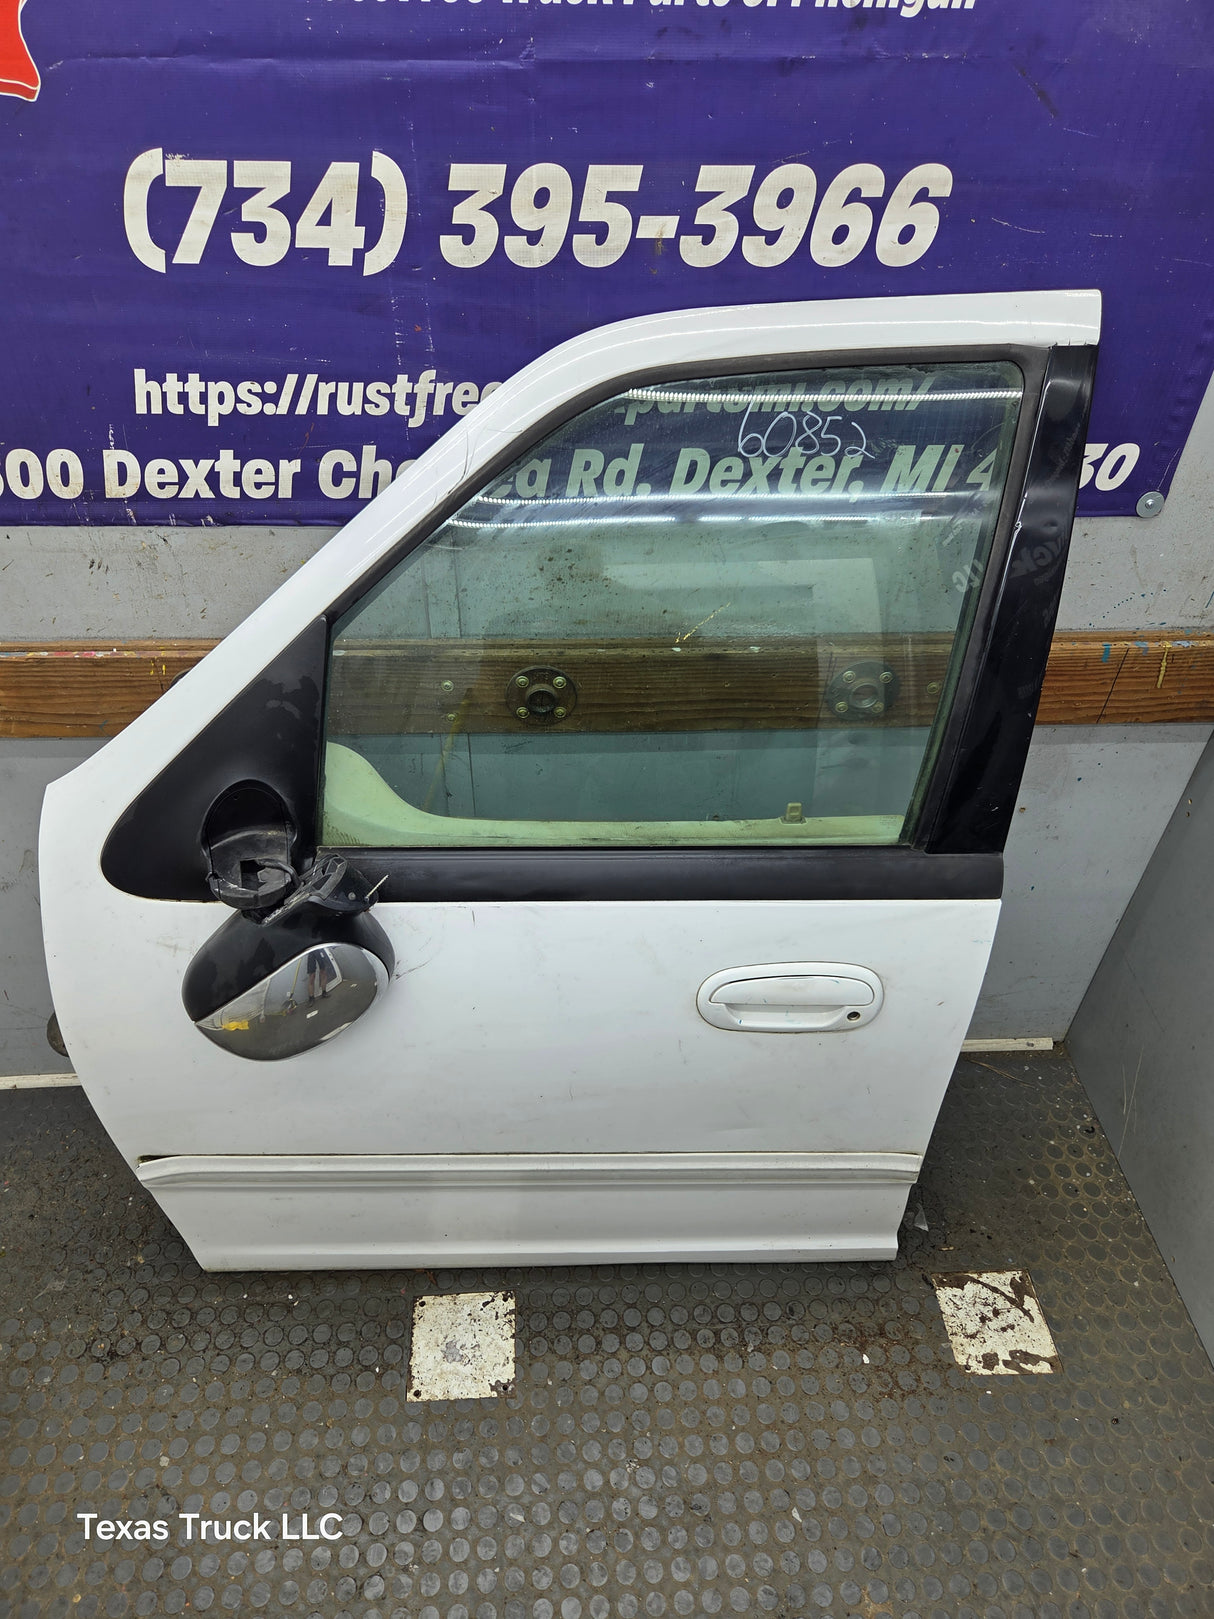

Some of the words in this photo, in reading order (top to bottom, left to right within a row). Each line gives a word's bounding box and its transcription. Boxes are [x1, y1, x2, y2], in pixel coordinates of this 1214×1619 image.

[124, 147, 408, 276] (734)
[439, 163, 953, 268] 395-3966
[738, 399, 876, 459] 60852
[0, 448, 84, 500] 00
[102, 449, 302, 499] Dexter
[565, 443, 652, 499] Rd.
[880, 444, 965, 492] MI
